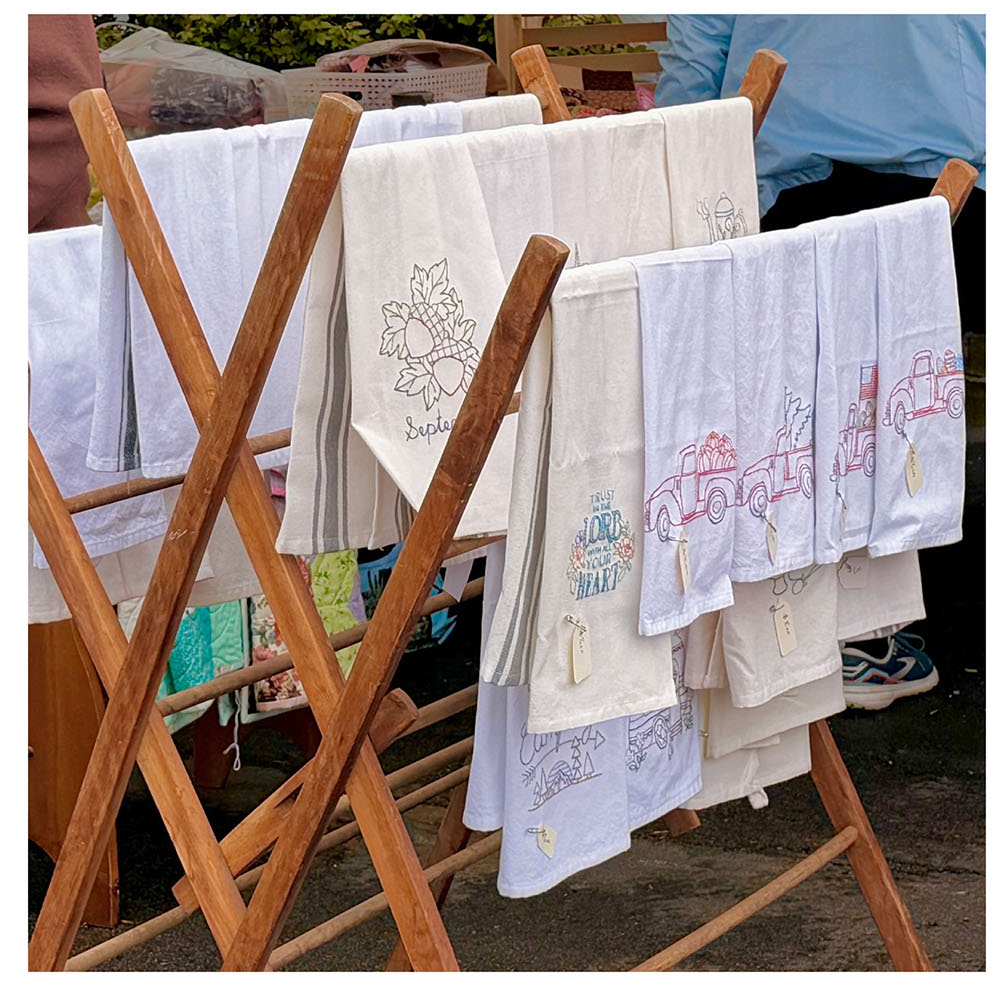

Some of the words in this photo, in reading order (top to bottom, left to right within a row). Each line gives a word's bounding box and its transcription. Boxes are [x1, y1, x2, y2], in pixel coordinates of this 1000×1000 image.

[405, 408, 456, 445] Septe
[590, 490, 615, 504] TRUST
[583, 509, 622, 549] LORD
[586, 552, 612, 570] YOUR
[577, 560, 621, 600] HEART
